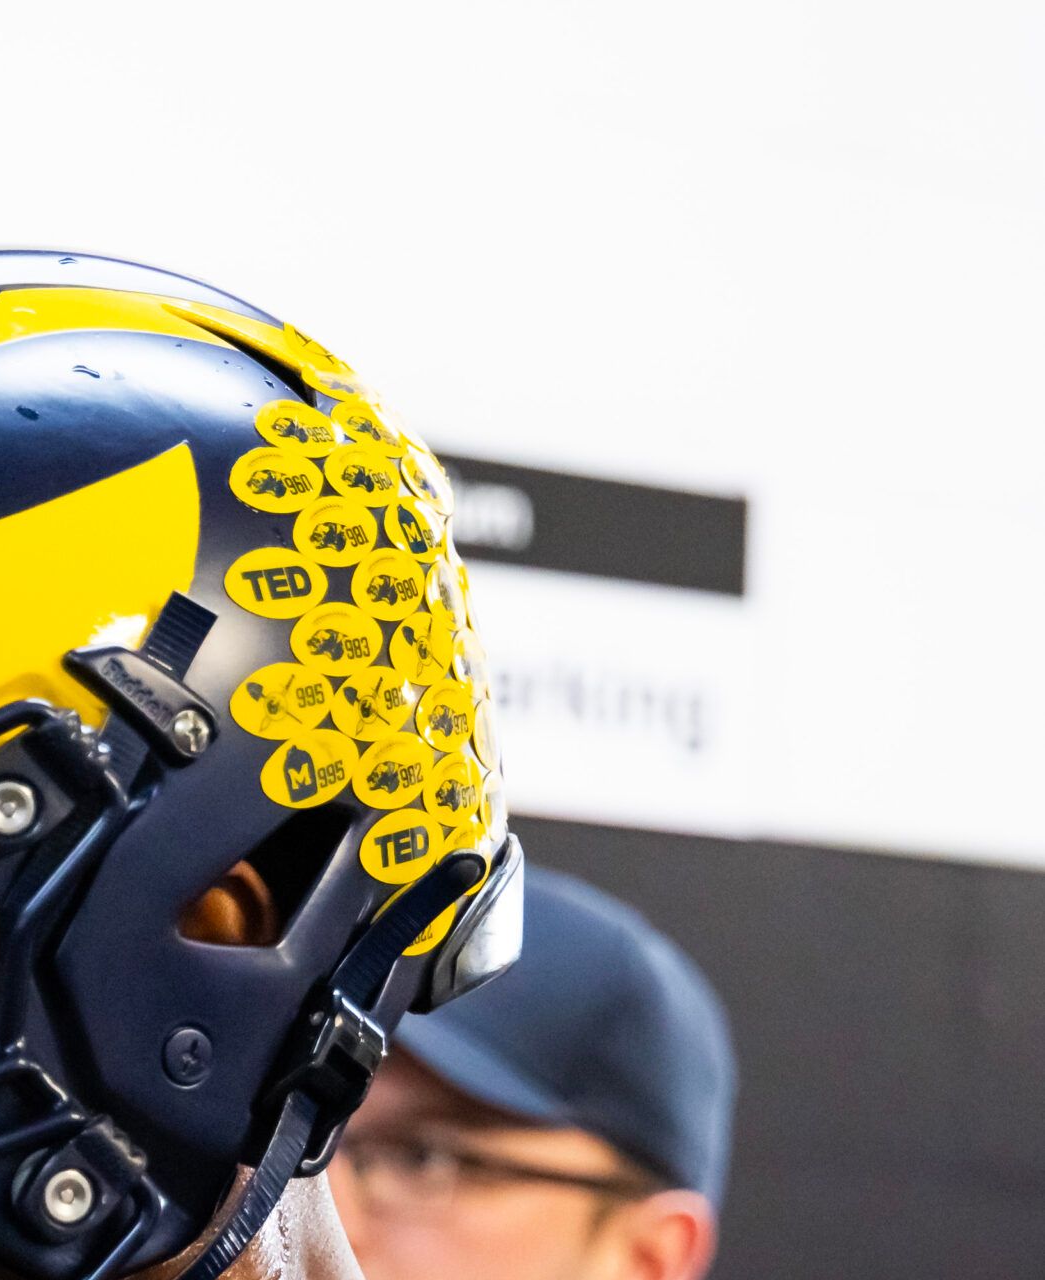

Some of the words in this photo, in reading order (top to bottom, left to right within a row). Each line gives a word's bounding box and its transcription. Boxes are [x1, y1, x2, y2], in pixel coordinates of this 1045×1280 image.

[283, 473, 314, 495] 960
[345, 524, 370, 547] 981
[402, 521, 423, 543] M
[241, 565, 312, 602] TED
[395, 577, 419, 602] 980
[344, 636, 371, 660] 983
[295, 682, 325, 709] 995
[287, 762, 313, 790] M
[317, 759, 346, 789] 995
[373, 824, 430, 869] TED
